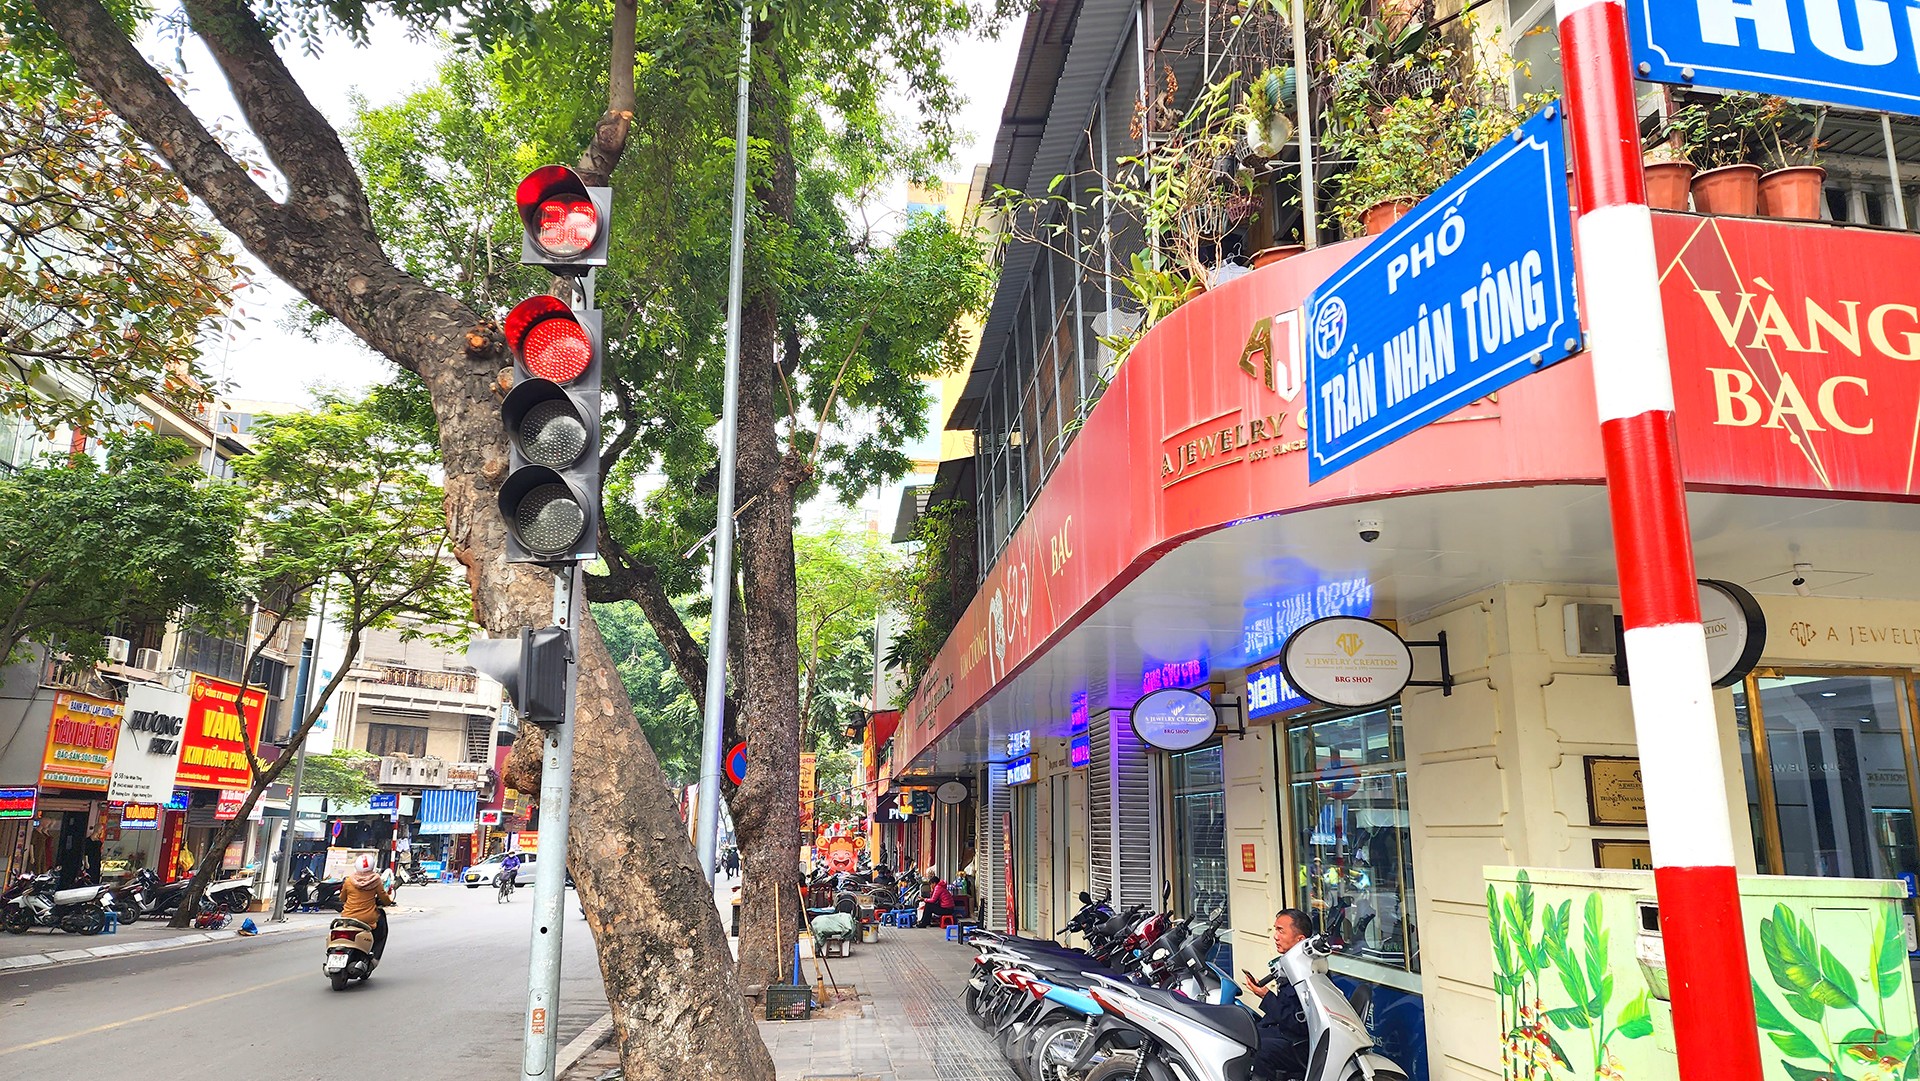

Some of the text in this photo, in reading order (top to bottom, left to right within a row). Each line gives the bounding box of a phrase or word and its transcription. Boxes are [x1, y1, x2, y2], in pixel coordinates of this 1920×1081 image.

[1697, 0, 1920, 73] HU
[1387, 191, 1467, 295] PHỐ
[1320, 250, 1547, 445] TRẦN NHÂN TÔNG
[1694, 276, 1920, 361] VÀNG
[1705, 367, 1874, 445] BẠC
[1161, 452, 1175, 479] A
[1177, 411, 1288, 476] JEWELRY
[1050, 515, 1073, 577] BẠC
[1313, 658, 1351, 667] JEWELRY
[1353, 658, 1398, 667] CREATION
[1827, 626, 1839, 642] A
[183, 745, 204, 765] KIM
[126, 805, 156, 819] VÀNG
